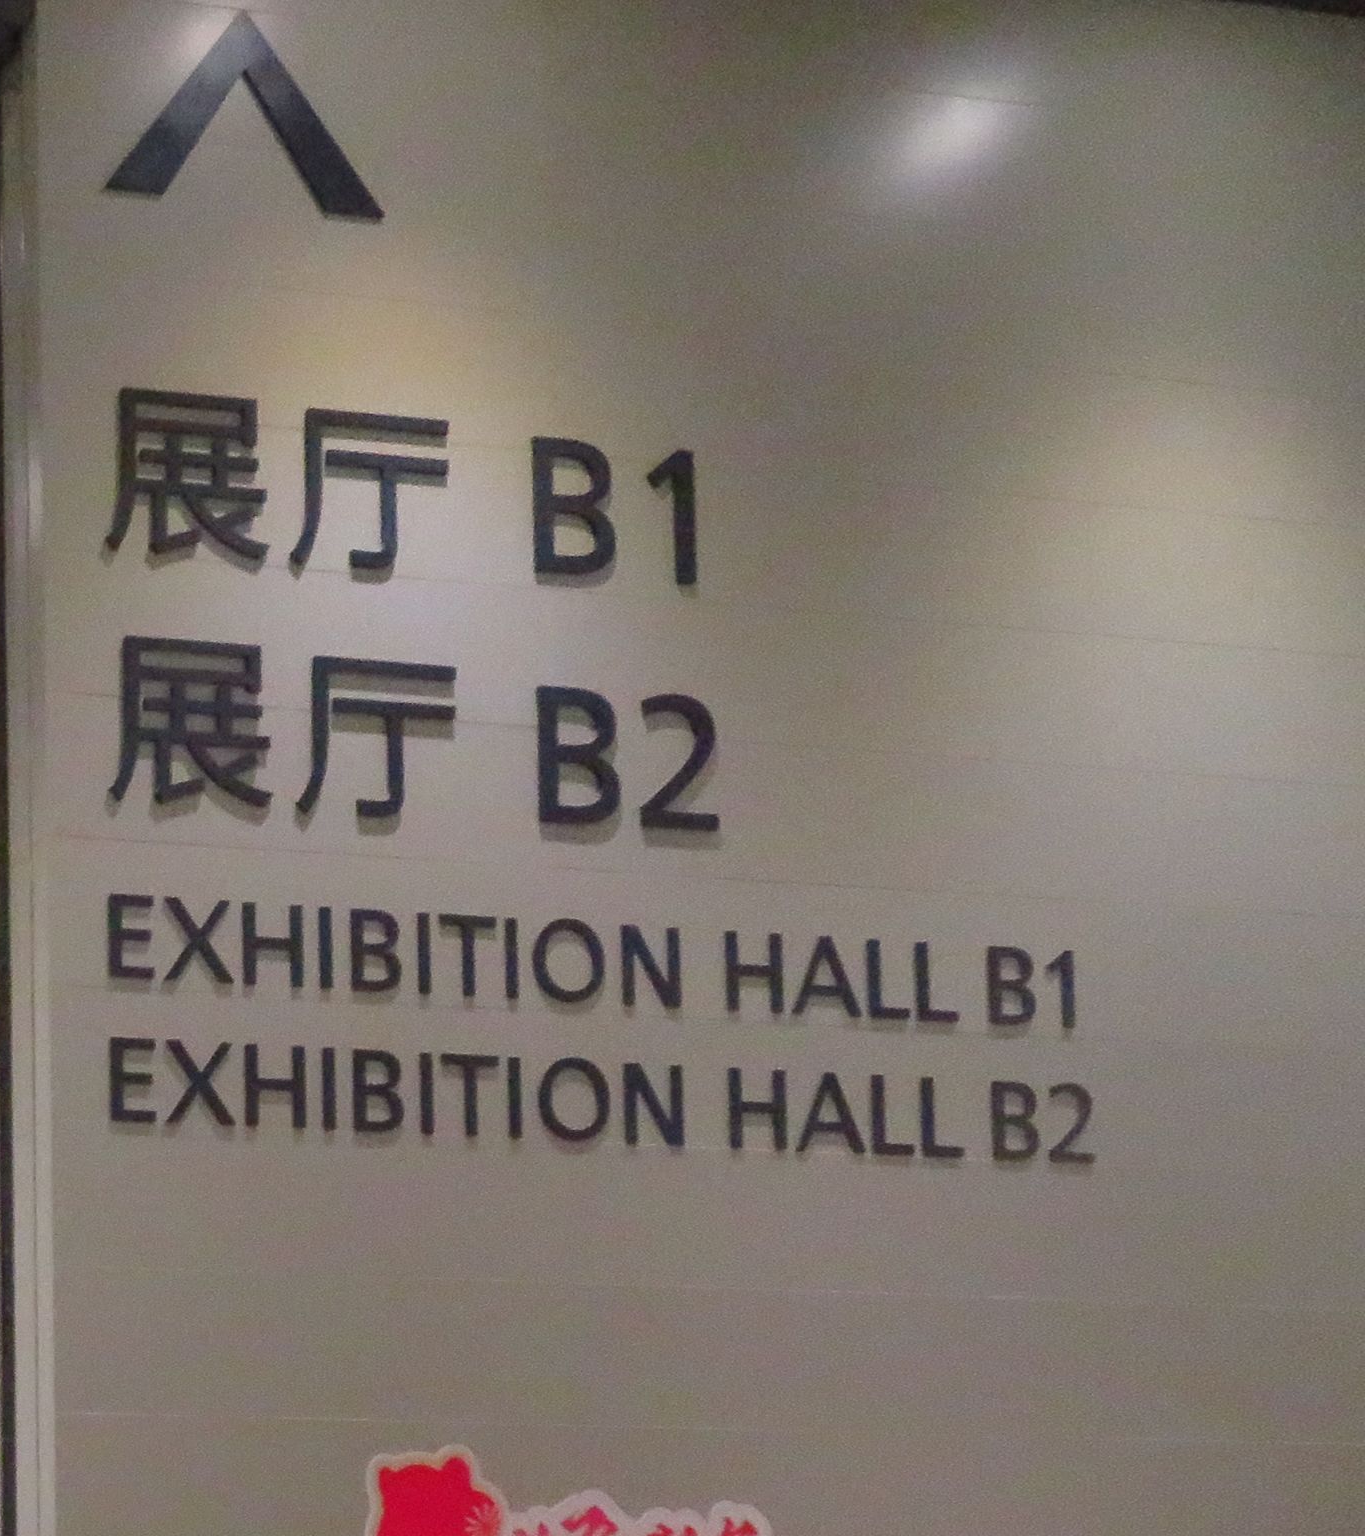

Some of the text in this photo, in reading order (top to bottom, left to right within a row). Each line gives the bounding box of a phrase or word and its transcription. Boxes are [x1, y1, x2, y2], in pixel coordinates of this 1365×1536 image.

[105, 386, 698, 588] 展厅 B1
[107, 635, 720, 834] 展厅 B2
[106, 893, 1077, 1030] EXHIBITION HALL B1
[107, 1036, 1094, 1164] EXHIBITION HALL B2
